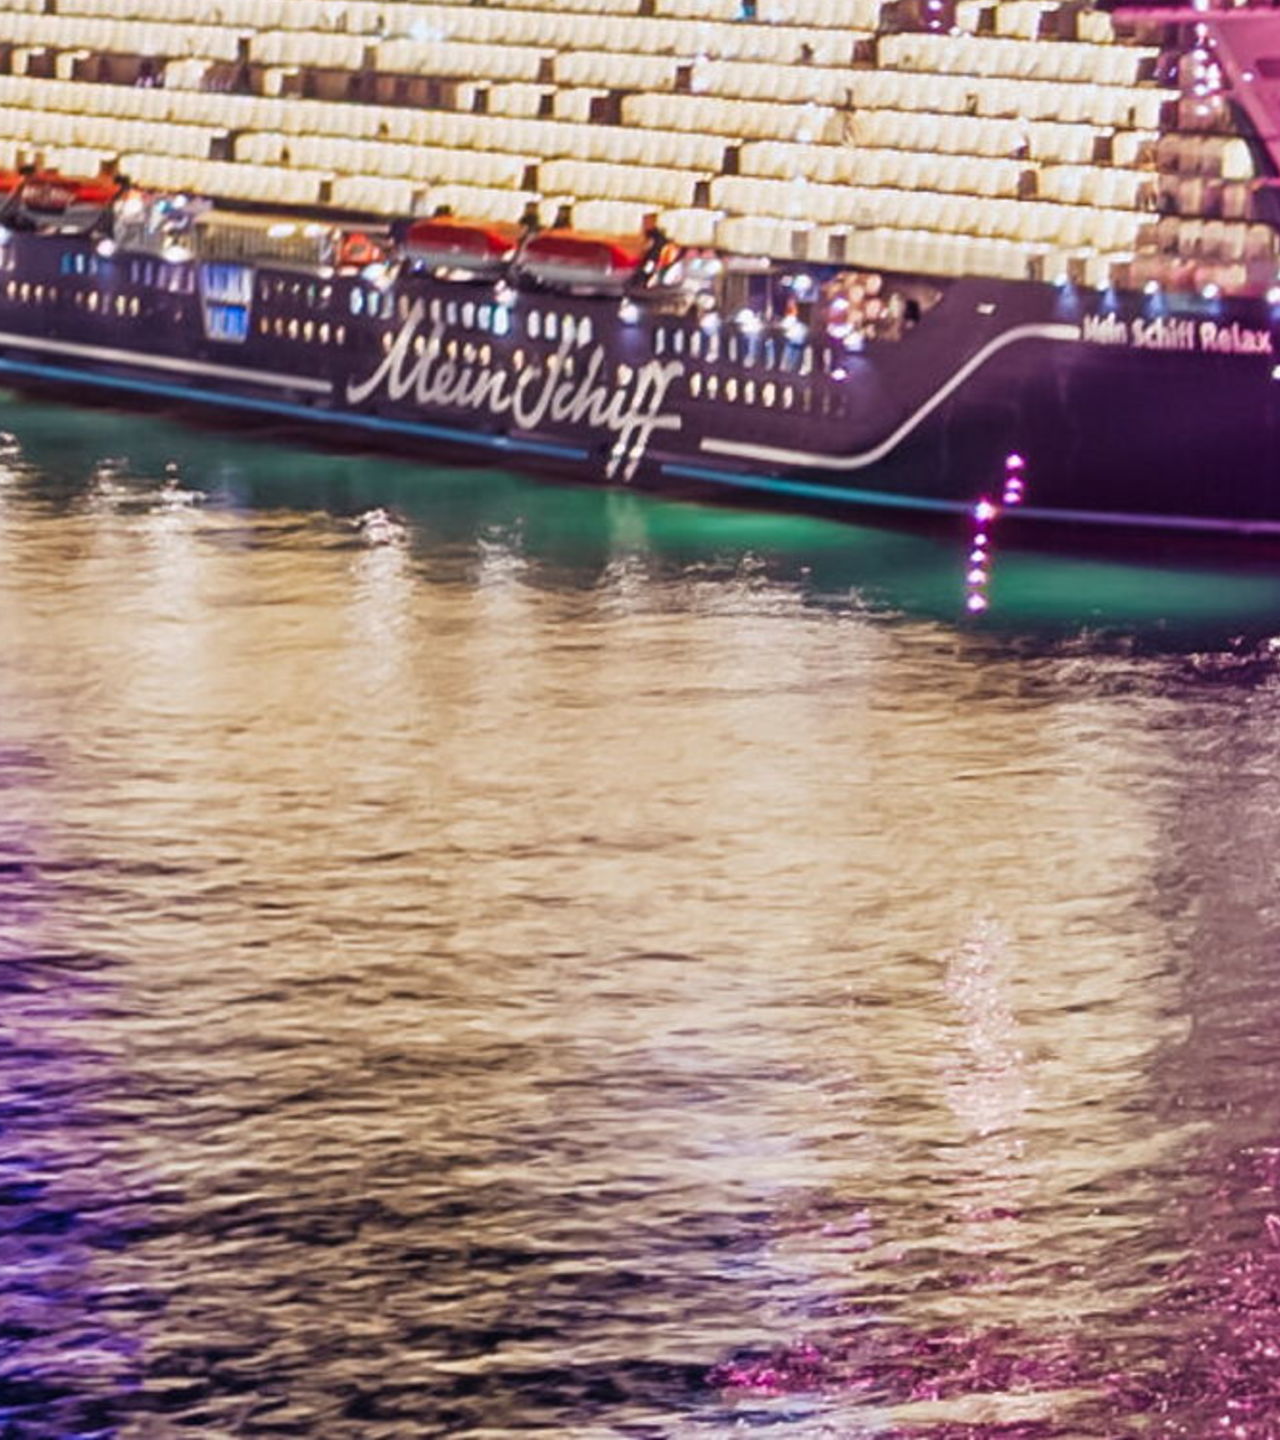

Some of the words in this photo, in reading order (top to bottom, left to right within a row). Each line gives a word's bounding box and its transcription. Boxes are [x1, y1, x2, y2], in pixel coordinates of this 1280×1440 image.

[346, 298, 513, 411] Mein
[514, 332, 684, 482] Schiff
[1200, 321, 1273, 354] Relax
